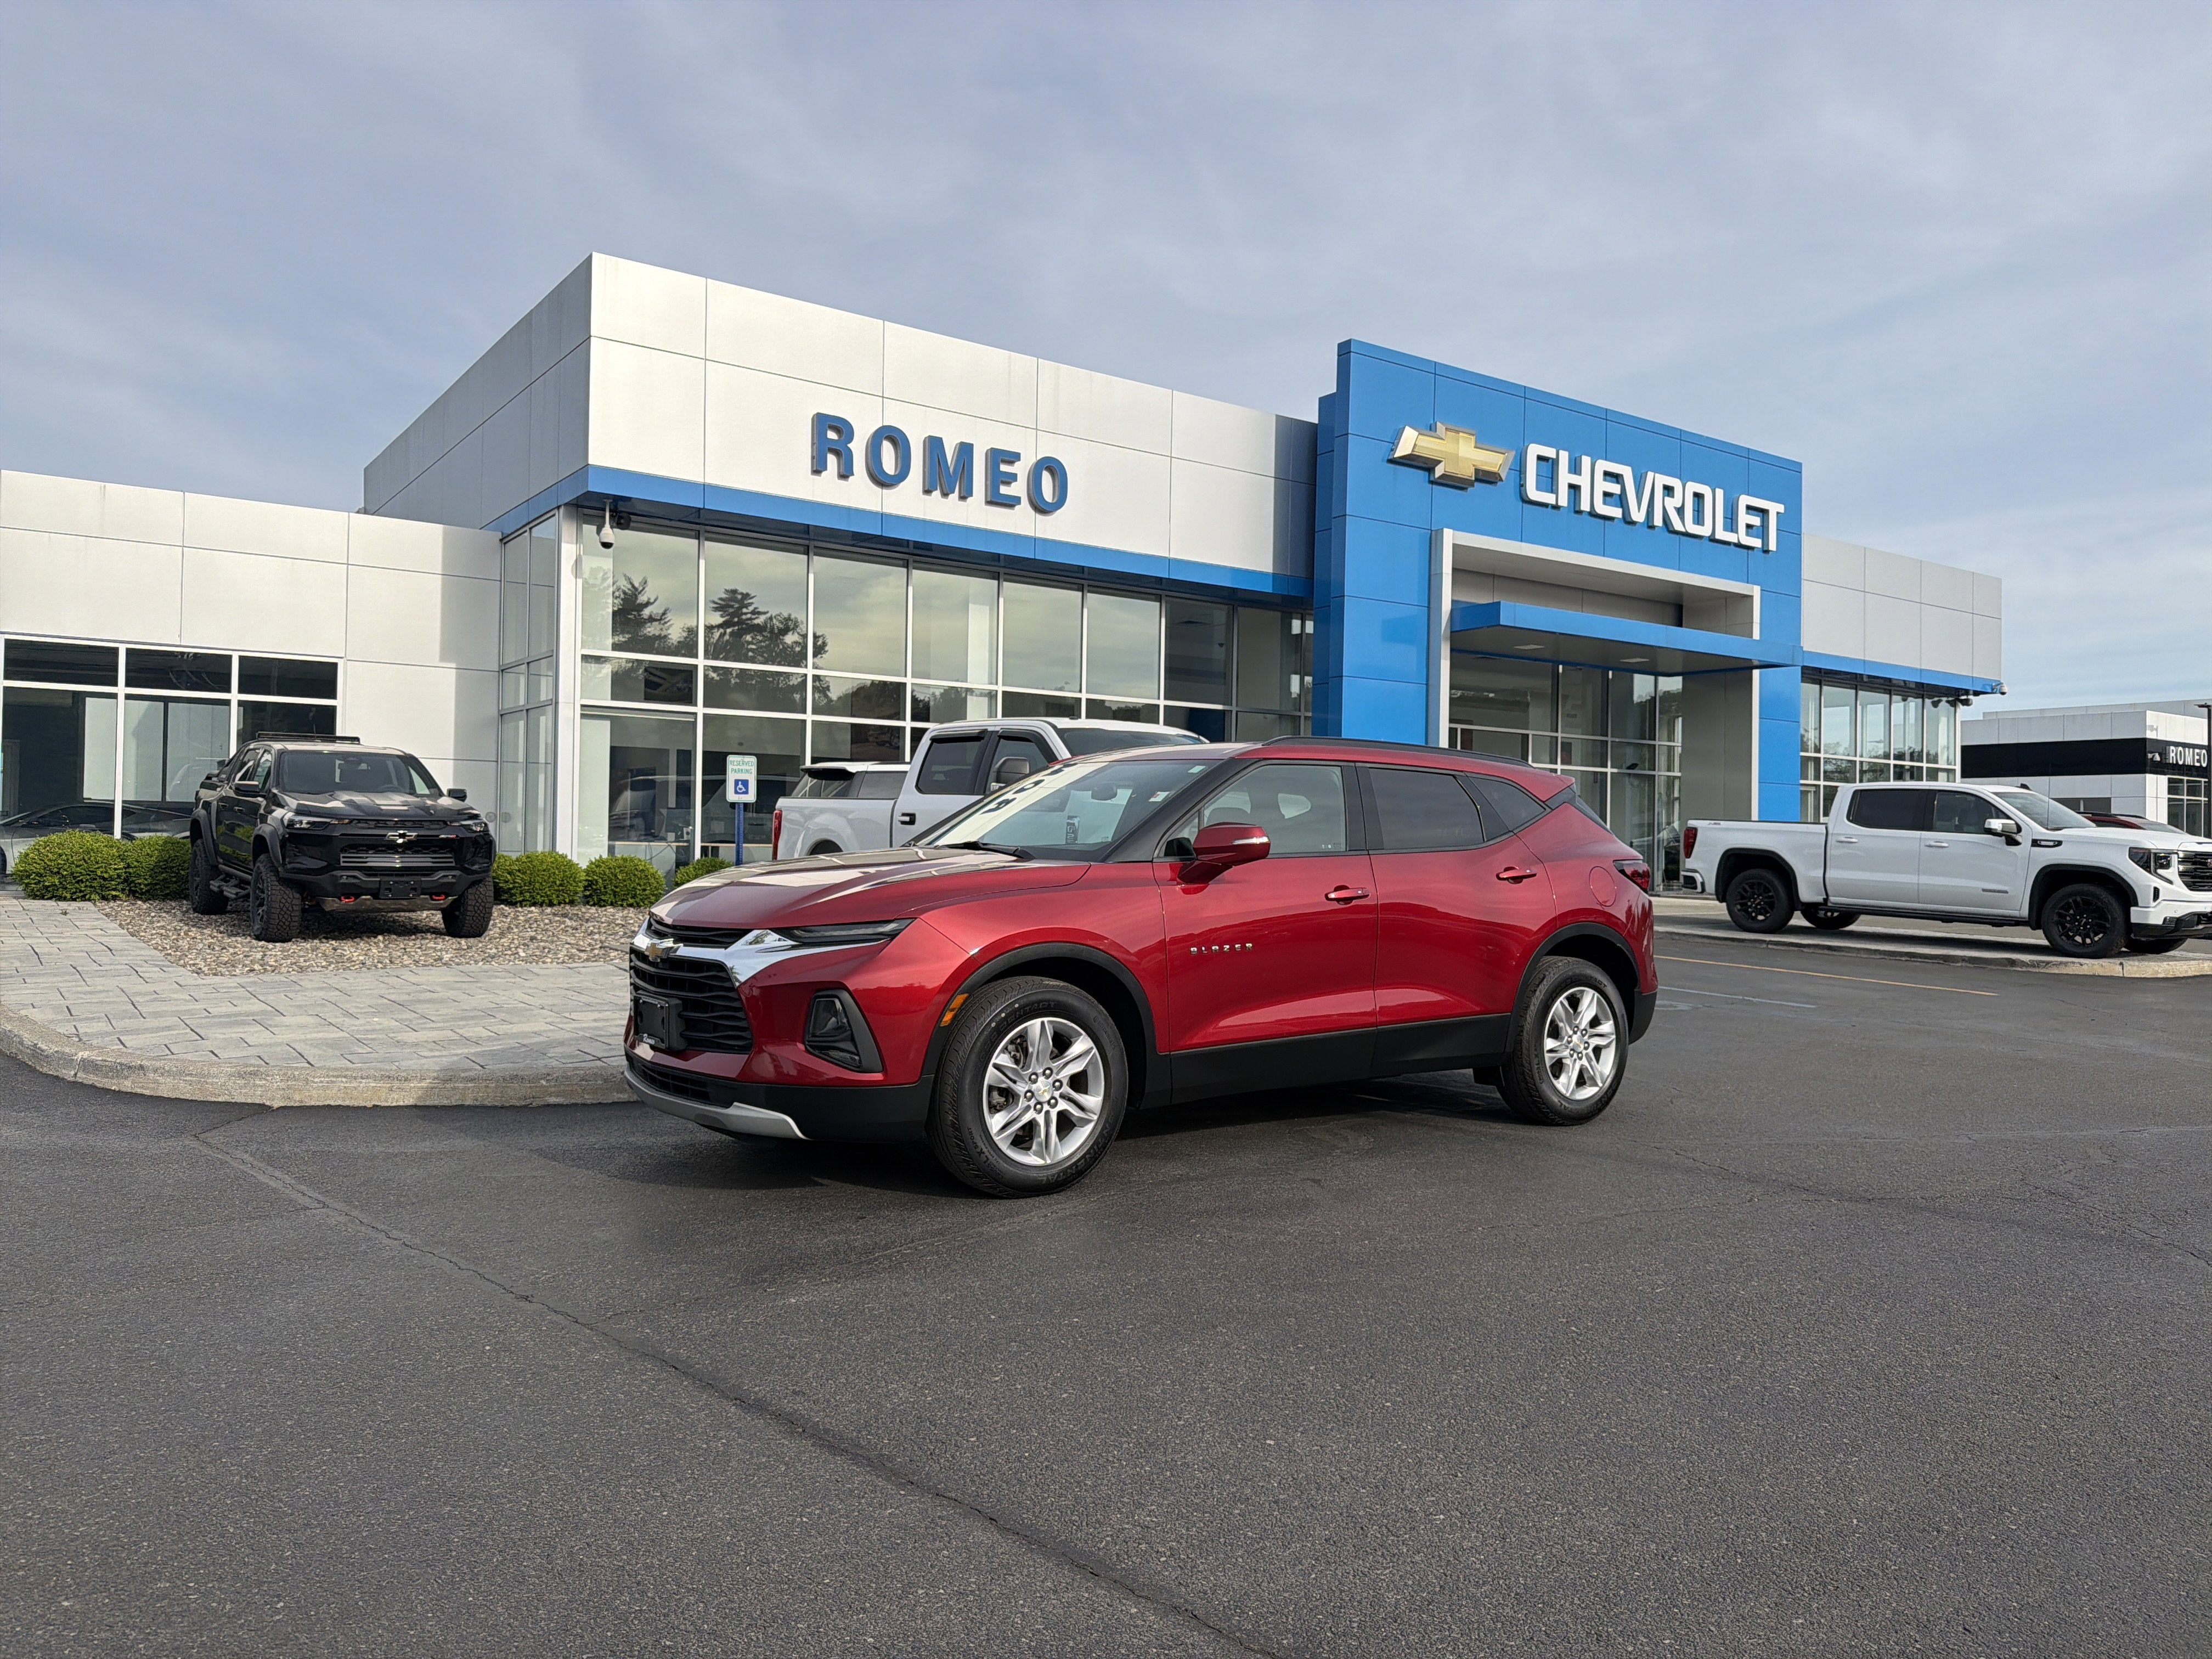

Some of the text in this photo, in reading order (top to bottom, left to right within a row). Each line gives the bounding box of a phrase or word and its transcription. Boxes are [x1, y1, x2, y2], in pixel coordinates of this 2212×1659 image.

[811, 412, 1068, 513] ROMEO
[1521, 443, 1785, 551] CHEVROLET
[2170, 746, 2208, 767] ROMEO
[1190, 943, 1252, 955] BLAZER
